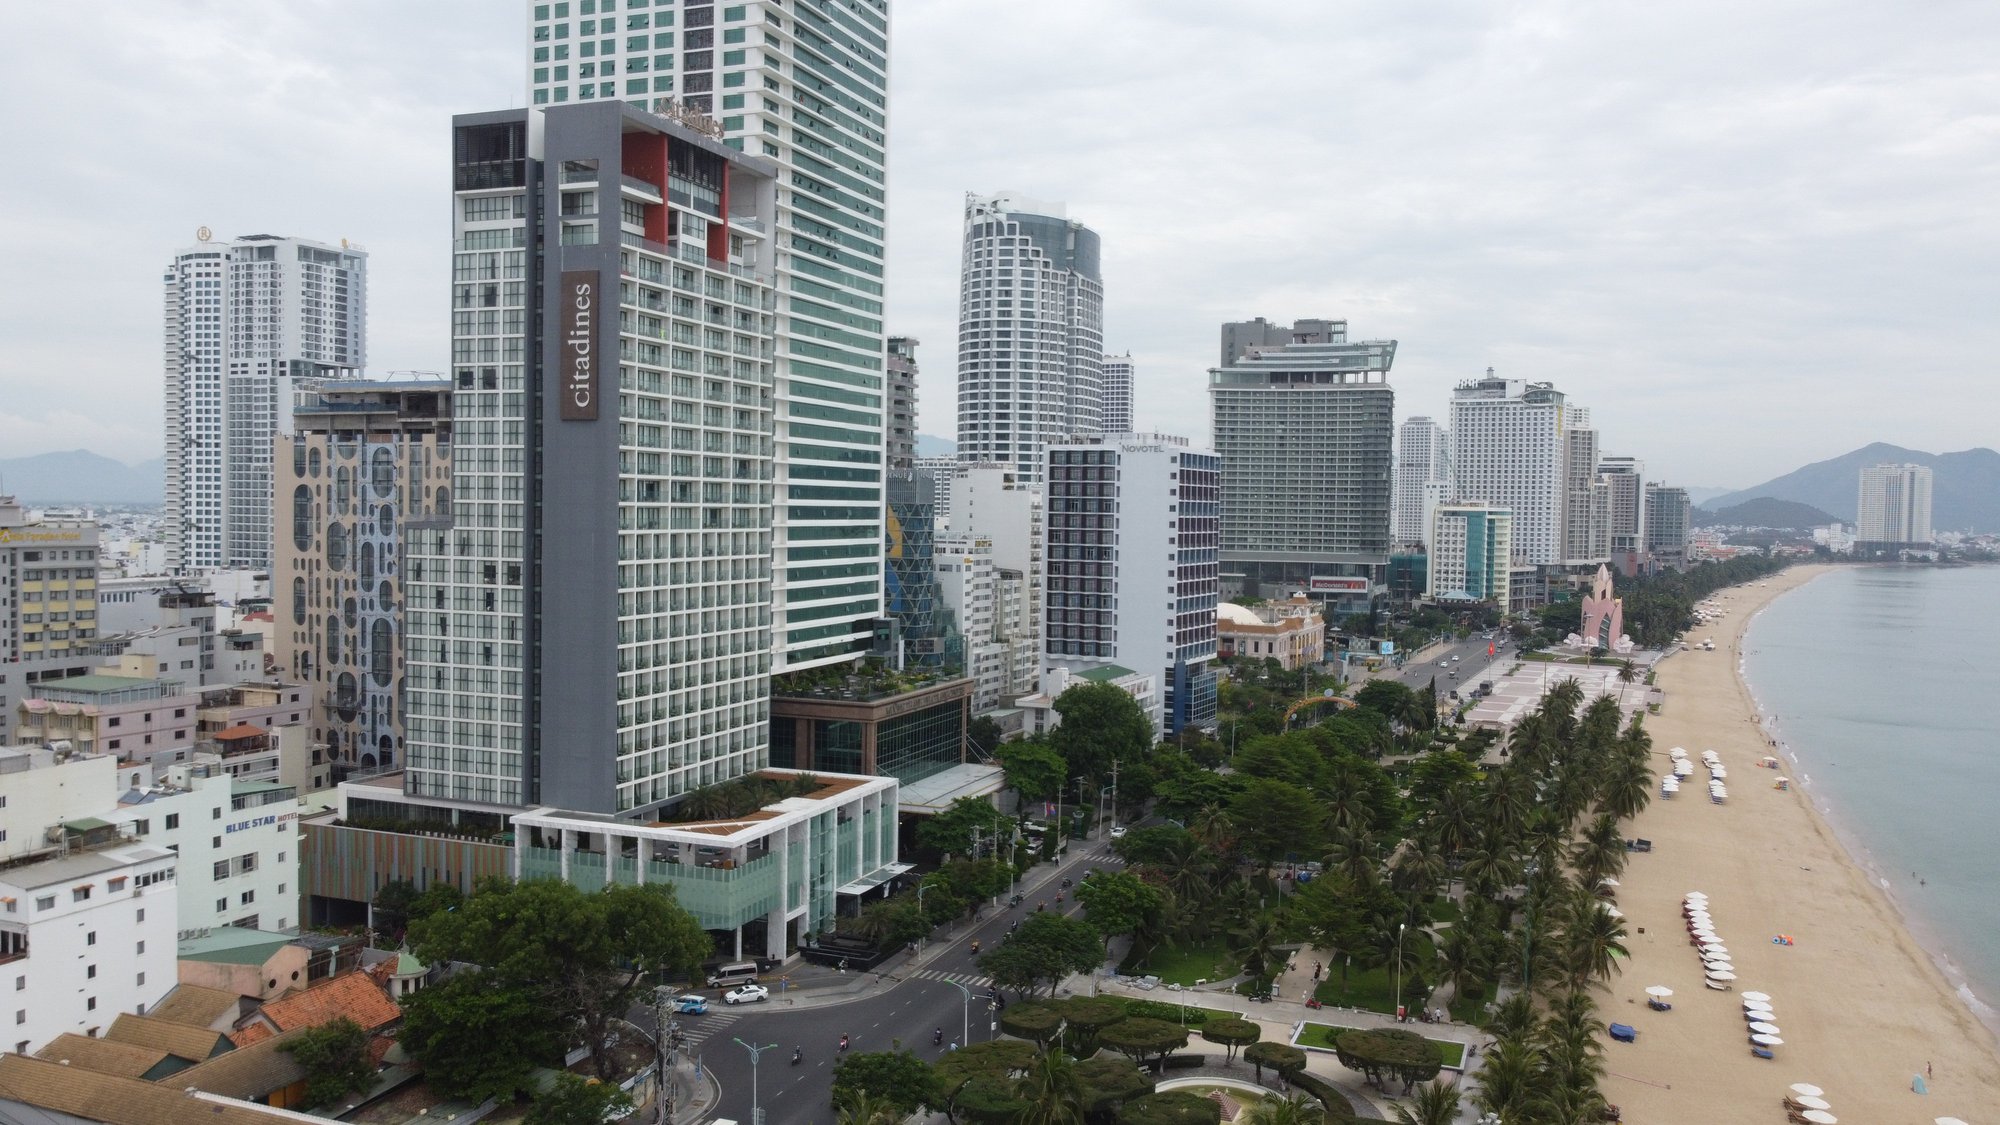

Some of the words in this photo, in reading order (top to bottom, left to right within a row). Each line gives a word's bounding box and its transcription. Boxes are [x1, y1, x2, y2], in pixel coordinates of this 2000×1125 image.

[1121, 444, 1165, 453] NOVOTEL
[226, 820, 250, 834] BLUE
[252, 815, 276, 828] STAR
[277, 811, 298, 822] HOTEL
